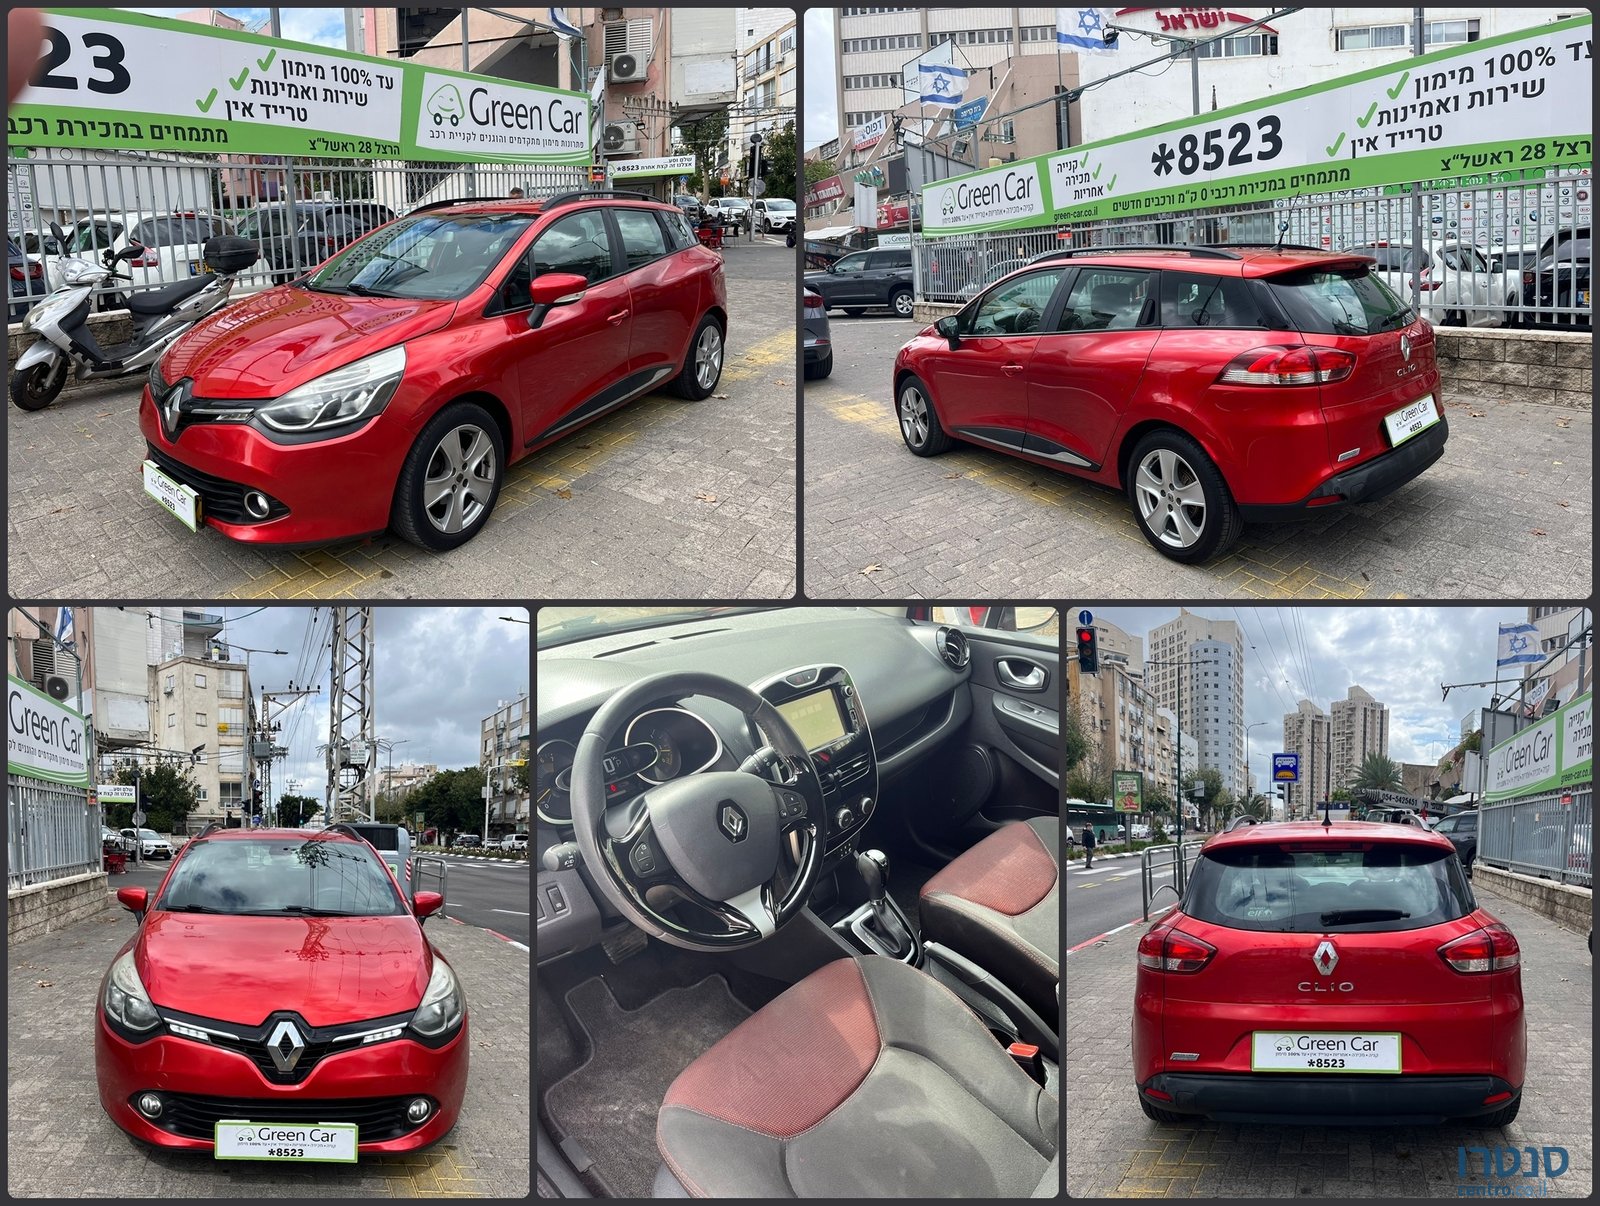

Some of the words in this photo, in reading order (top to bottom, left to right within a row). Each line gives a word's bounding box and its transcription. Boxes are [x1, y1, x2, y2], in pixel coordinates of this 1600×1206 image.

[1155, 10, 1225, 31] ישראל
[281, 59, 325, 80] מימון
[1484, 46, 1556, 79] 100%
[331, 65, 372, 87] 100%
[376, 74, 394, 90] עד
[1415, 66, 1474, 99] מימון
[251, 78, 317, 101] ואמינות
[323, 88, 368, 107] שירות
[1467, 78, 1545, 110] שירות
[225, 100, 255, 120] אין
[260, 103, 308, 122] טרייד
[469, 87, 543, 130] Green
[549, 99, 583, 134] Car
[1377, 95, 1459, 127] ואמינות
[57, 119, 144, 139] במכירת
[150, 124, 228, 143] מתמחים
[429, 130, 446, 139] רכב
[866, 119, 883, 135] דפוס
[1385, 125, 1442, 148] טרייד
[358, 141, 372, 153] 28
[375, 141, 400, 155] הרצל
[1351, 135, 1379, 158] אין
[1520, 143, 1546, 161] 28
[1057, 159, 1078, 174] קנייה
[1066, 172, 1090, 187] מכירה
[1239, 179, 1286, 196] במכירת
[1290, 168, 1350, 189] מתמחים
[957, 182, 1000, 210] Green
[1004, 171, 1034, 201] Car
[1074, 185, 1104, 200] אחריות
[1200, 188, 1208, 201] 0
[1210, 185, 1235, 199] רכבי
[1112, 198, 1142, 212] חדשים
[1144, 194, 1175, 208] ורכבים
[1054, 206, 1098, 222] green-car.co.il
[1396, 363, 1416, 377] CLIO
[1401, 406, 1418, 421] Green
[1417, 402, 1428, 413] Car
[9, 690, 59, 747] Green
[61, 716, 82, 755] Car
[1505, 743, 1531, 774] Green
[1533, 730, 1553, 762] Car
[1297, 982, 1354, 992] CLIO
[1297, 1035, 1346, 1051] Green
[1350, 1036, 1379, 1052] Car
[258, 1127, 305, 1142] Green
[309, 1129, 337, 1143] Car
